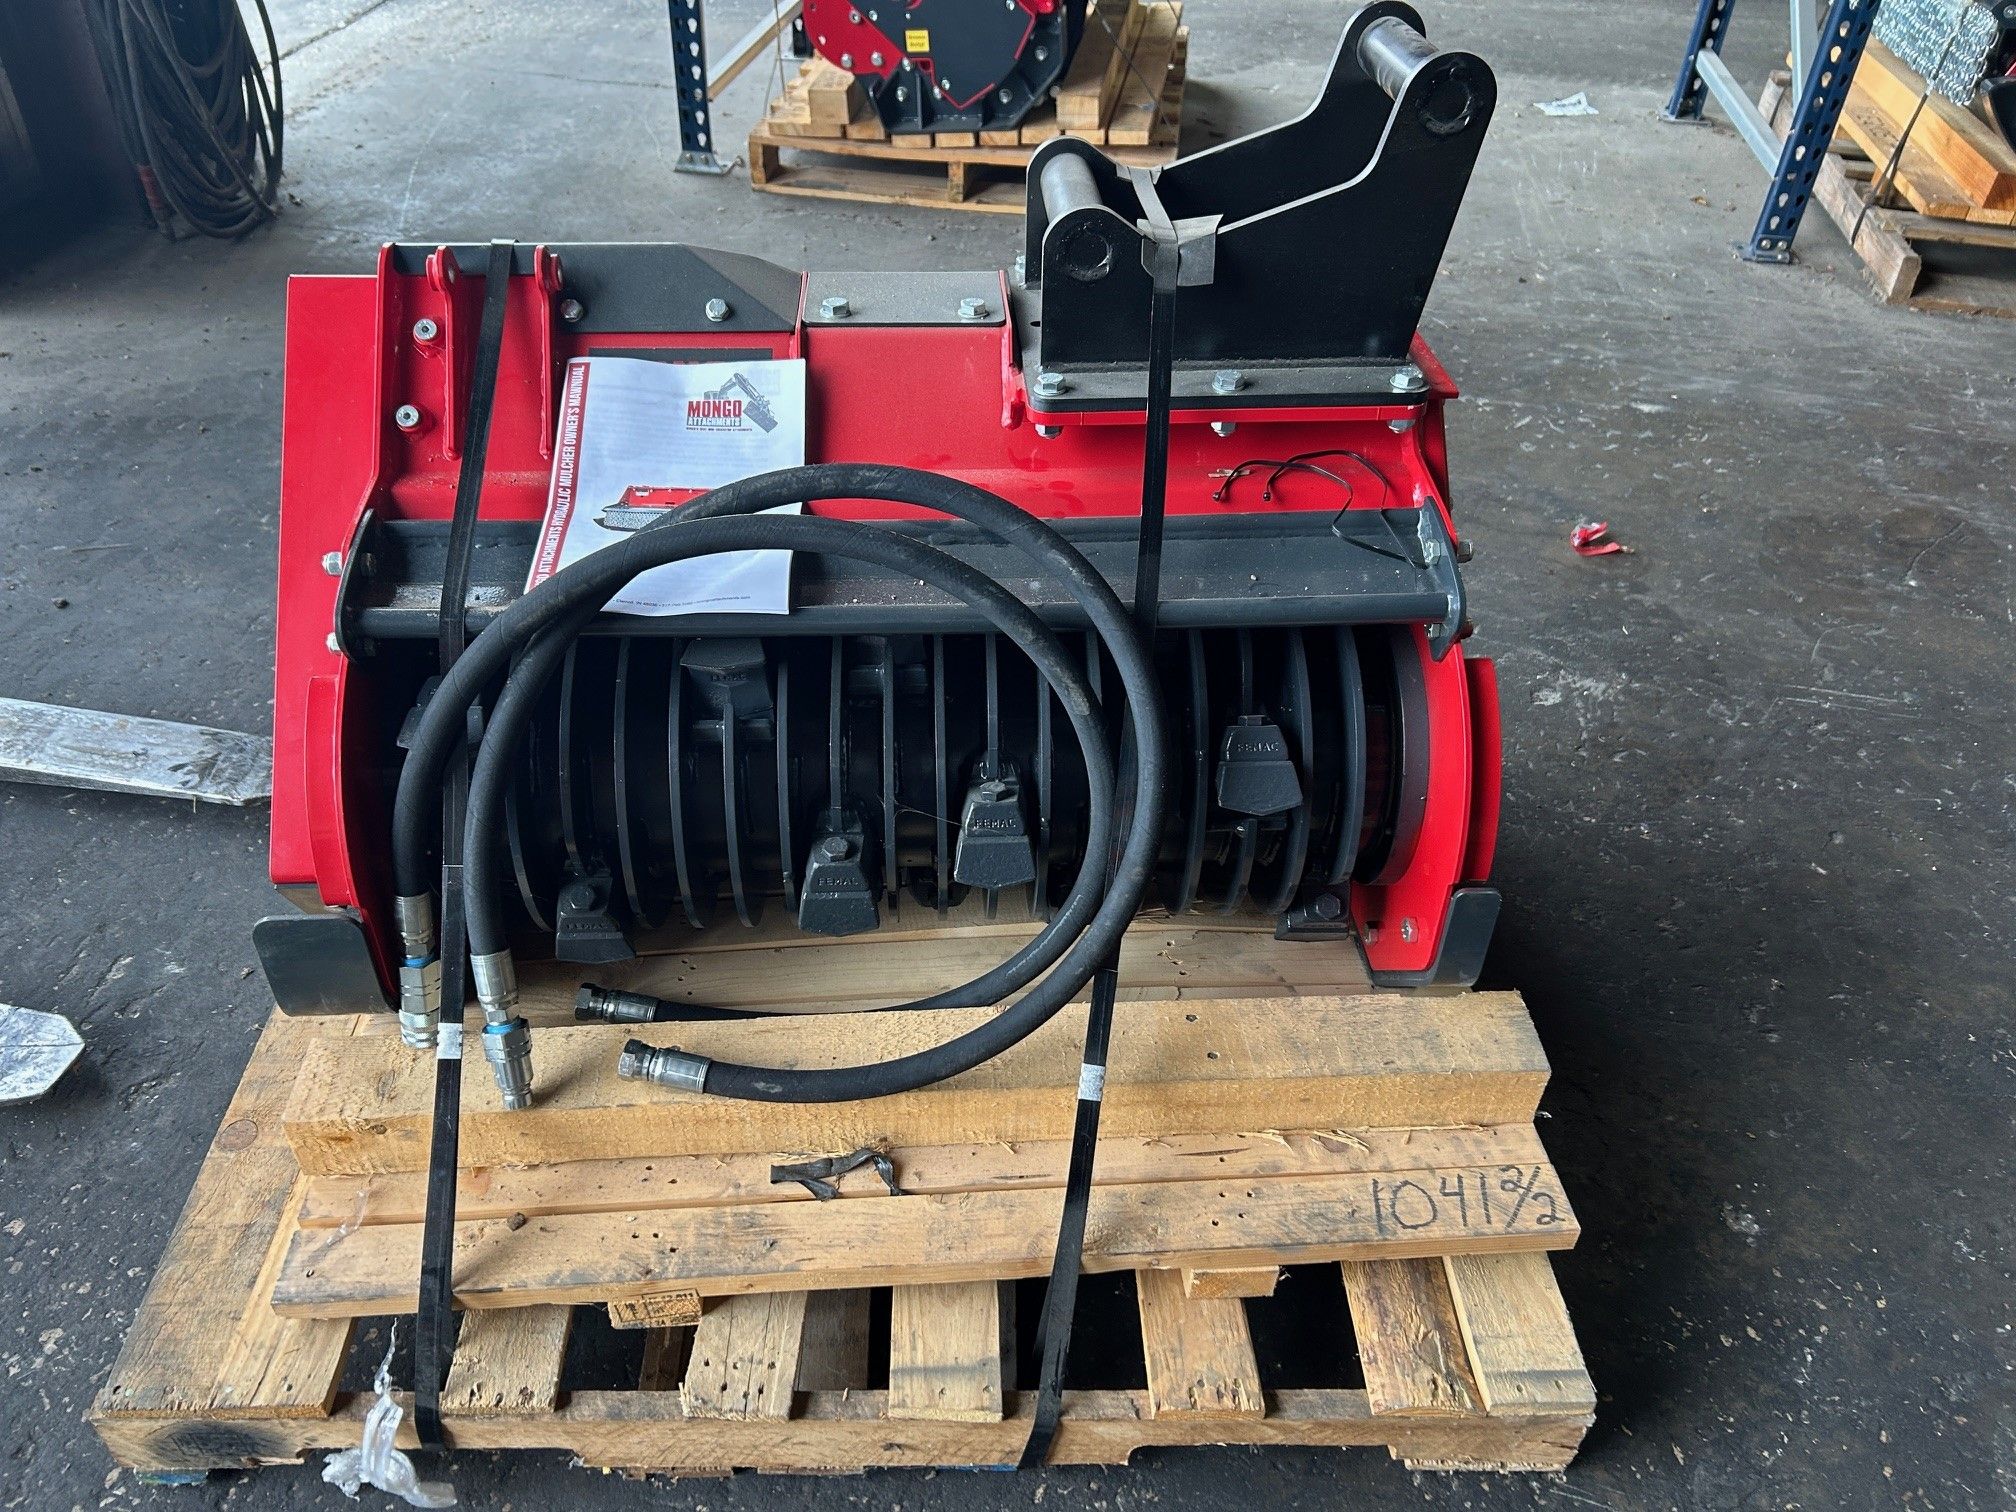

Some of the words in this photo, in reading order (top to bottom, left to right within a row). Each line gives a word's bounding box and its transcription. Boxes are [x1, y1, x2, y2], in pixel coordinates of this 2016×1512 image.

[568, 365, 586, 407] MAWNUAL
[563, 407, 581, 446] OWNER'S
[687, 400, 742, 418] MONGO
[687, 417, 741, 426] ATTACHMENTS
[559, 446, 576, 487] MULCHER
[550, 487, 571, 527] HYDRAULIC
[538, 526, 562, 573] ATTACHMENTS
[1372, 1171, 1492, 1234] 1041
